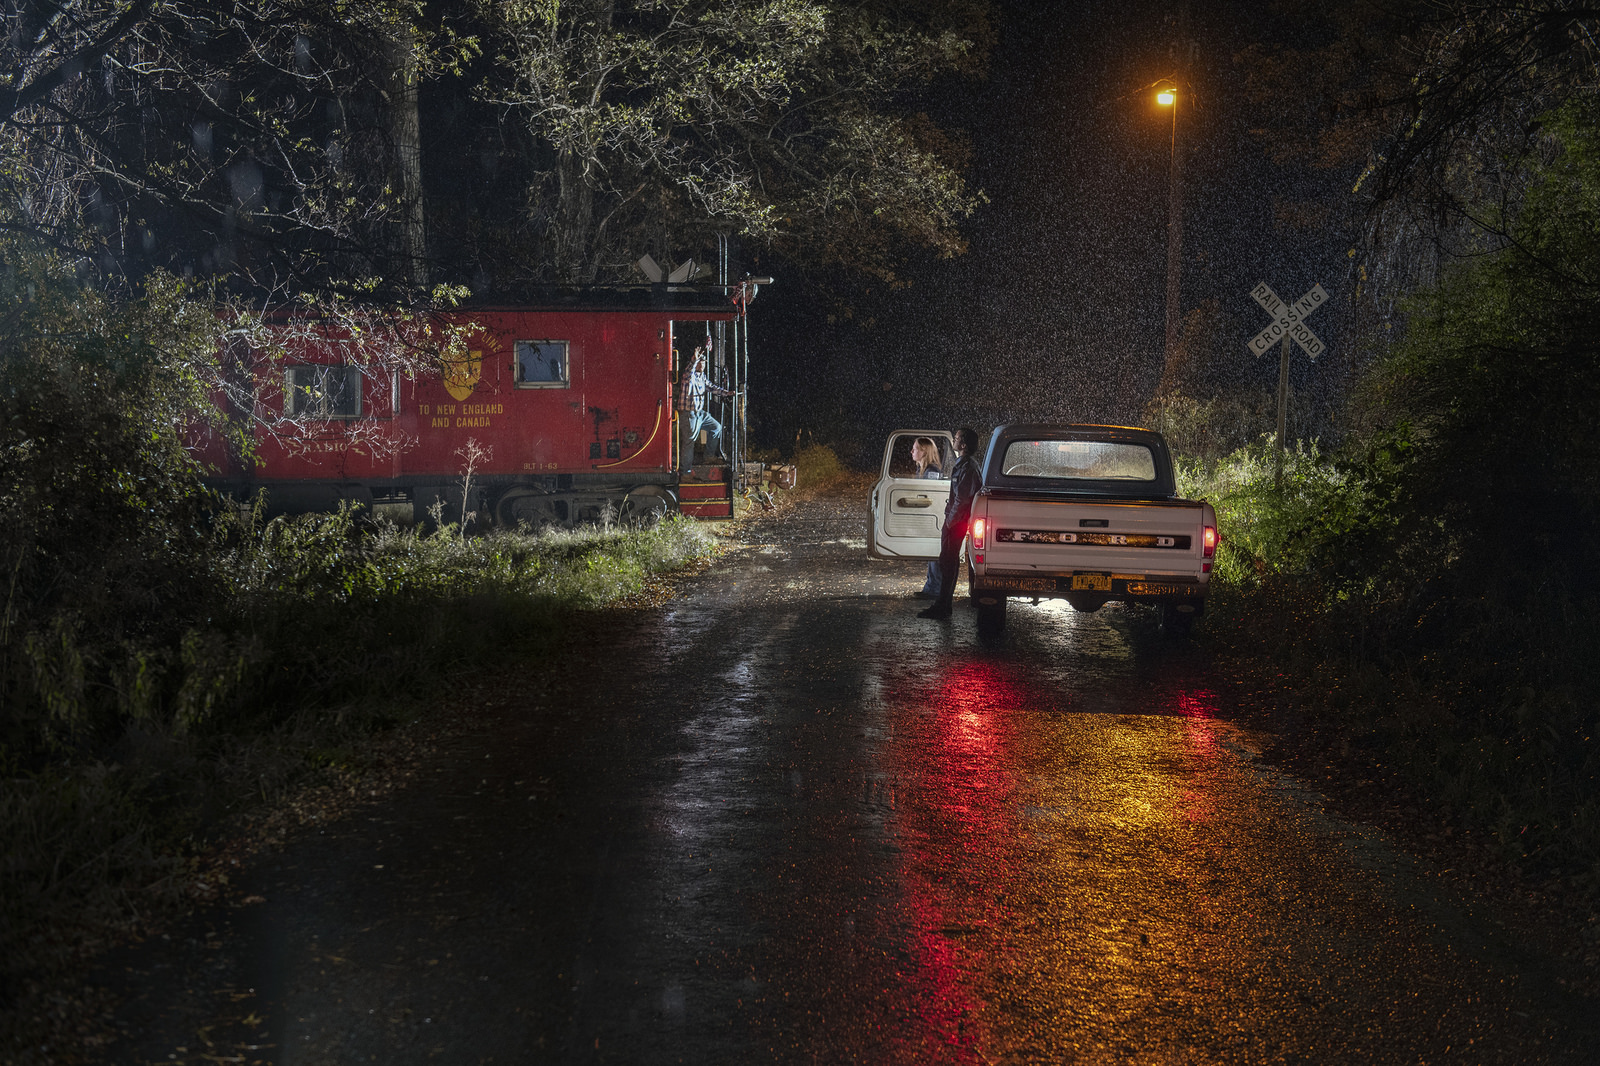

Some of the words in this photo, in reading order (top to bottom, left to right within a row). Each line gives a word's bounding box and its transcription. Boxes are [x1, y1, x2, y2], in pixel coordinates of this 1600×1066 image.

[1254, 286, 1281, 316] RAIL
[1291, 324, 1321, 354] ROAD
[1254, 291, 1322, 350] CROSSING
[481, 332, 504, 353] LINE
[418, 404, 430, 415] TO
[437, 404, 456, 415] NEW
[463, 403, 504, 415] ENGLAND
[431, 417, 450, 428] AND
[456, 416, 491, 428] CANADA
[1012, 530, 1175, 547] FORD
